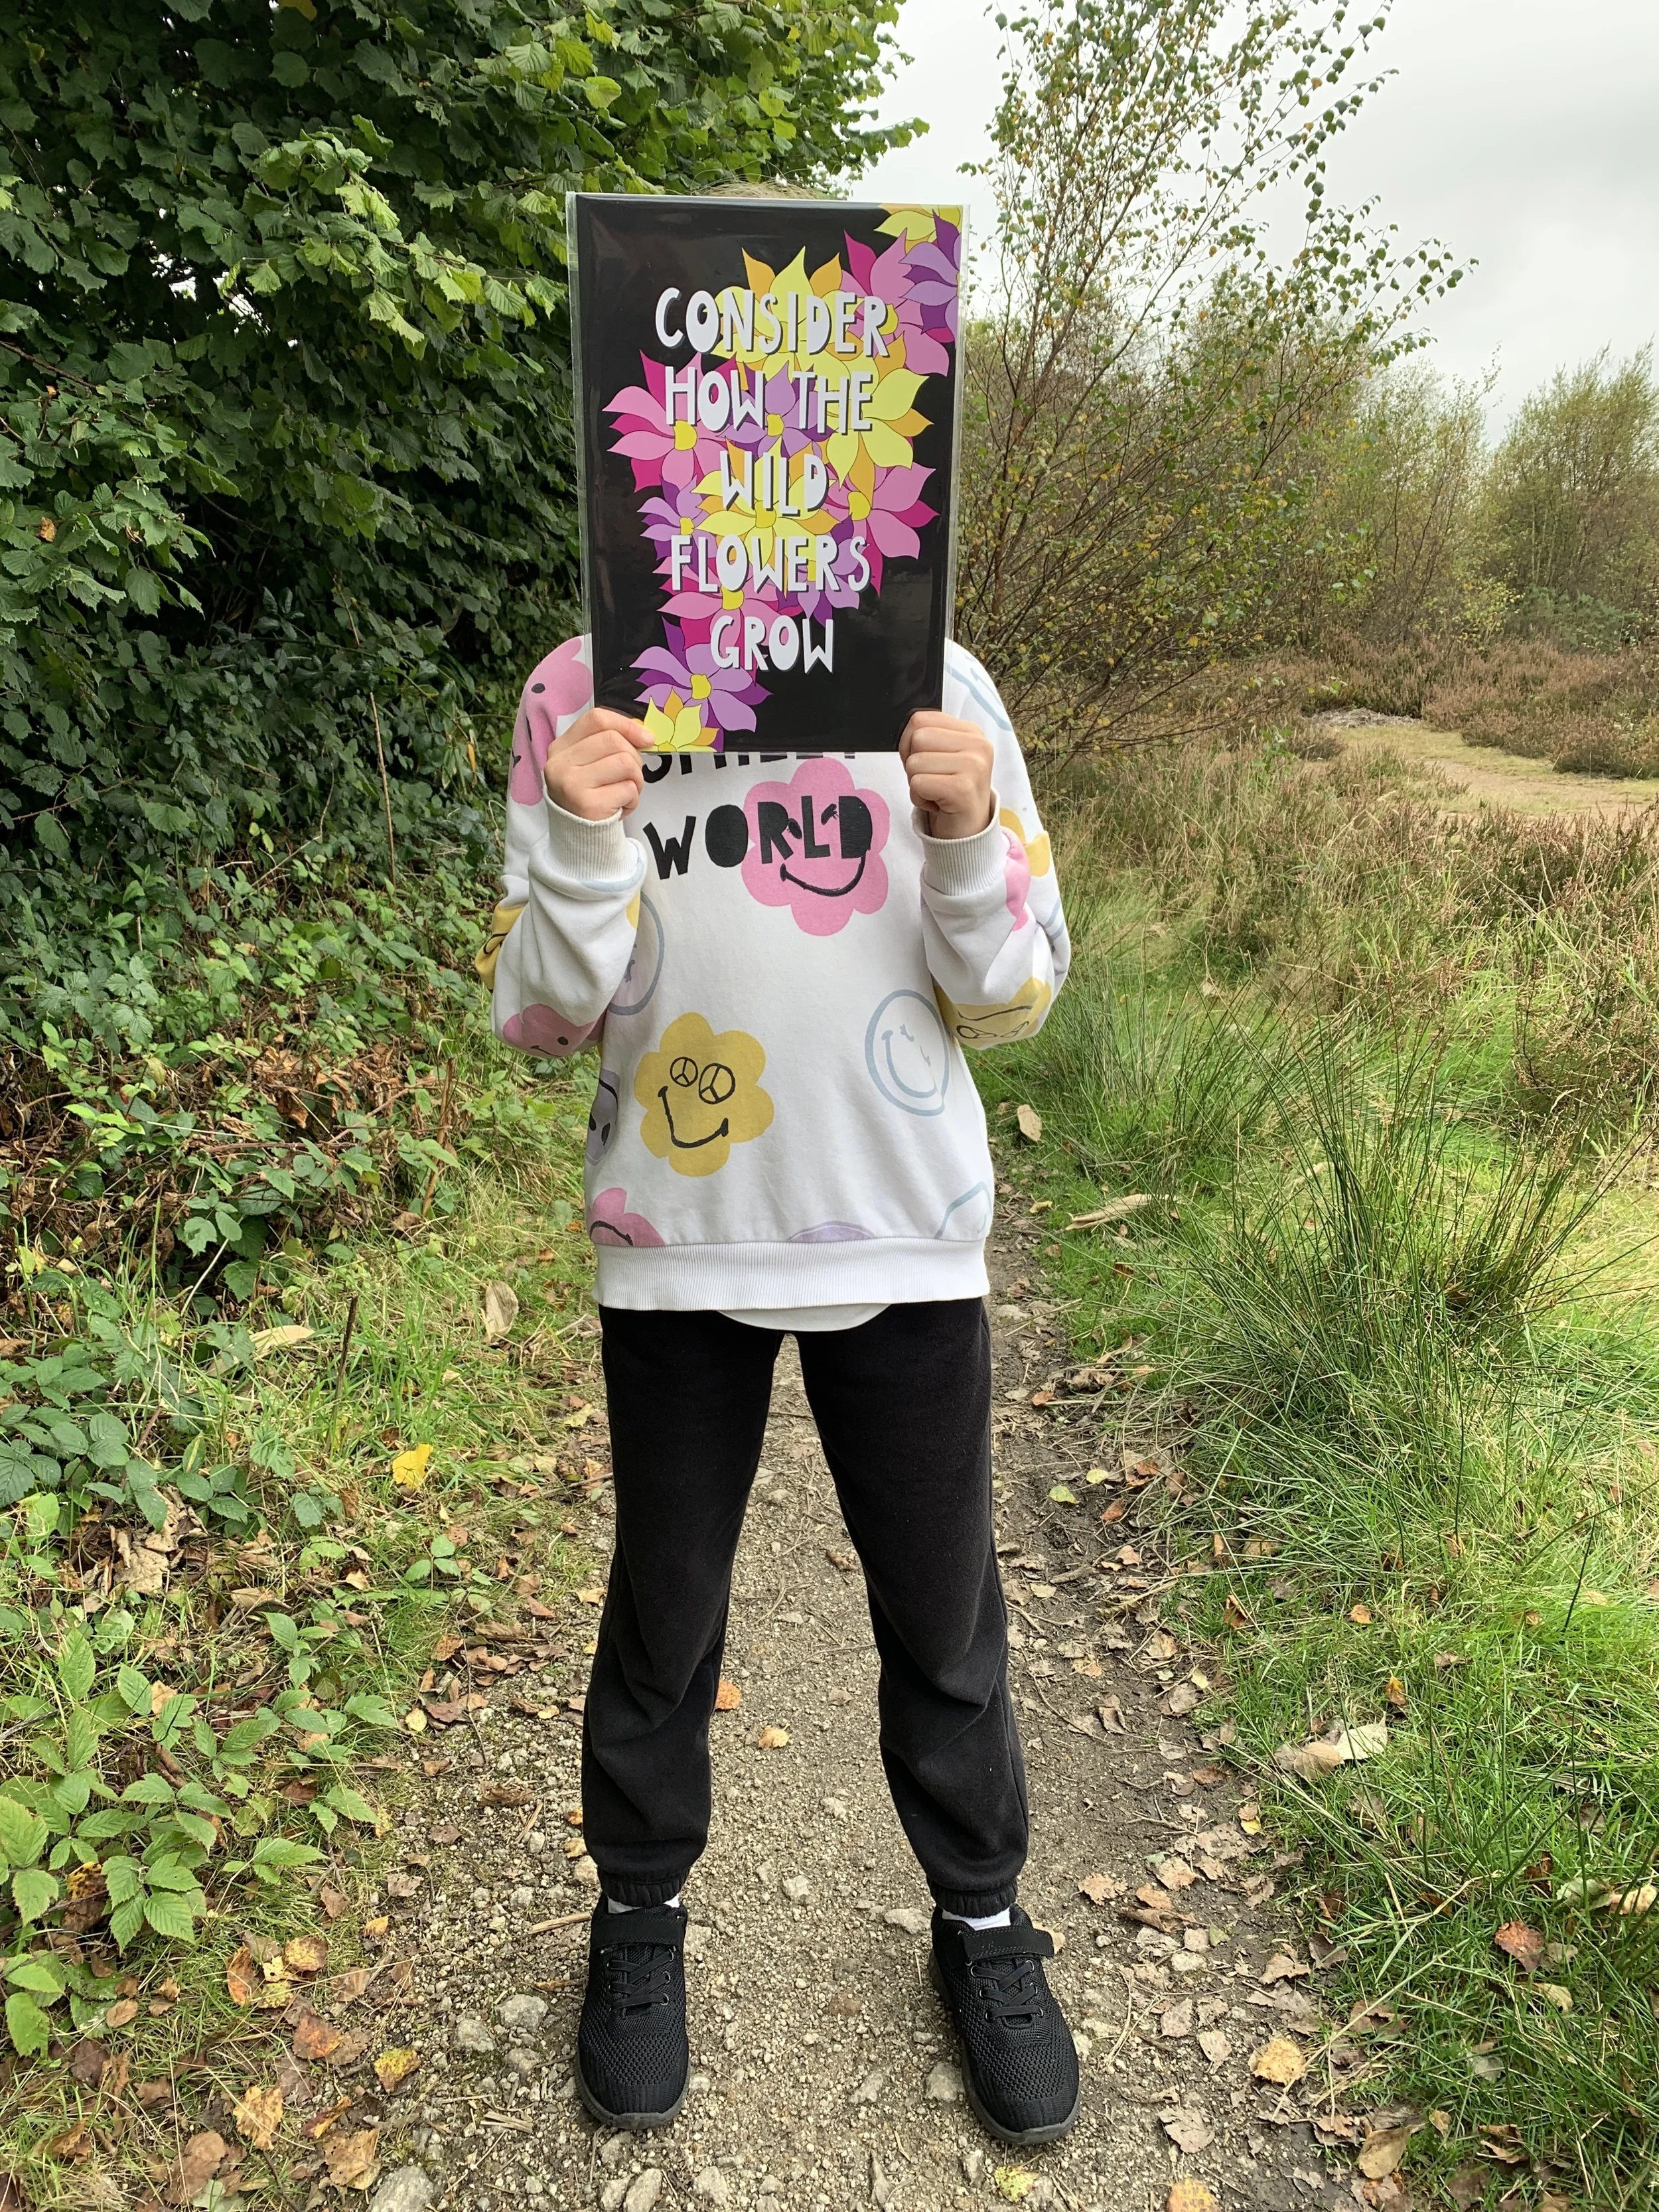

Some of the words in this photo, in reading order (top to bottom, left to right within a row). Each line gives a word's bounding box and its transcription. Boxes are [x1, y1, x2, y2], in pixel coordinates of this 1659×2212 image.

[654, 287, 889, 357] CONSIDER
[665, 366, 764, 432] HOW
[792, 370, 872, 435] THE
[719, 450, 828, 515] WILD
[670, 534, 871, 593] FLOWERS
[710, 615, 834, 674] GROW
[642, 796, 873, 879] WORLD
